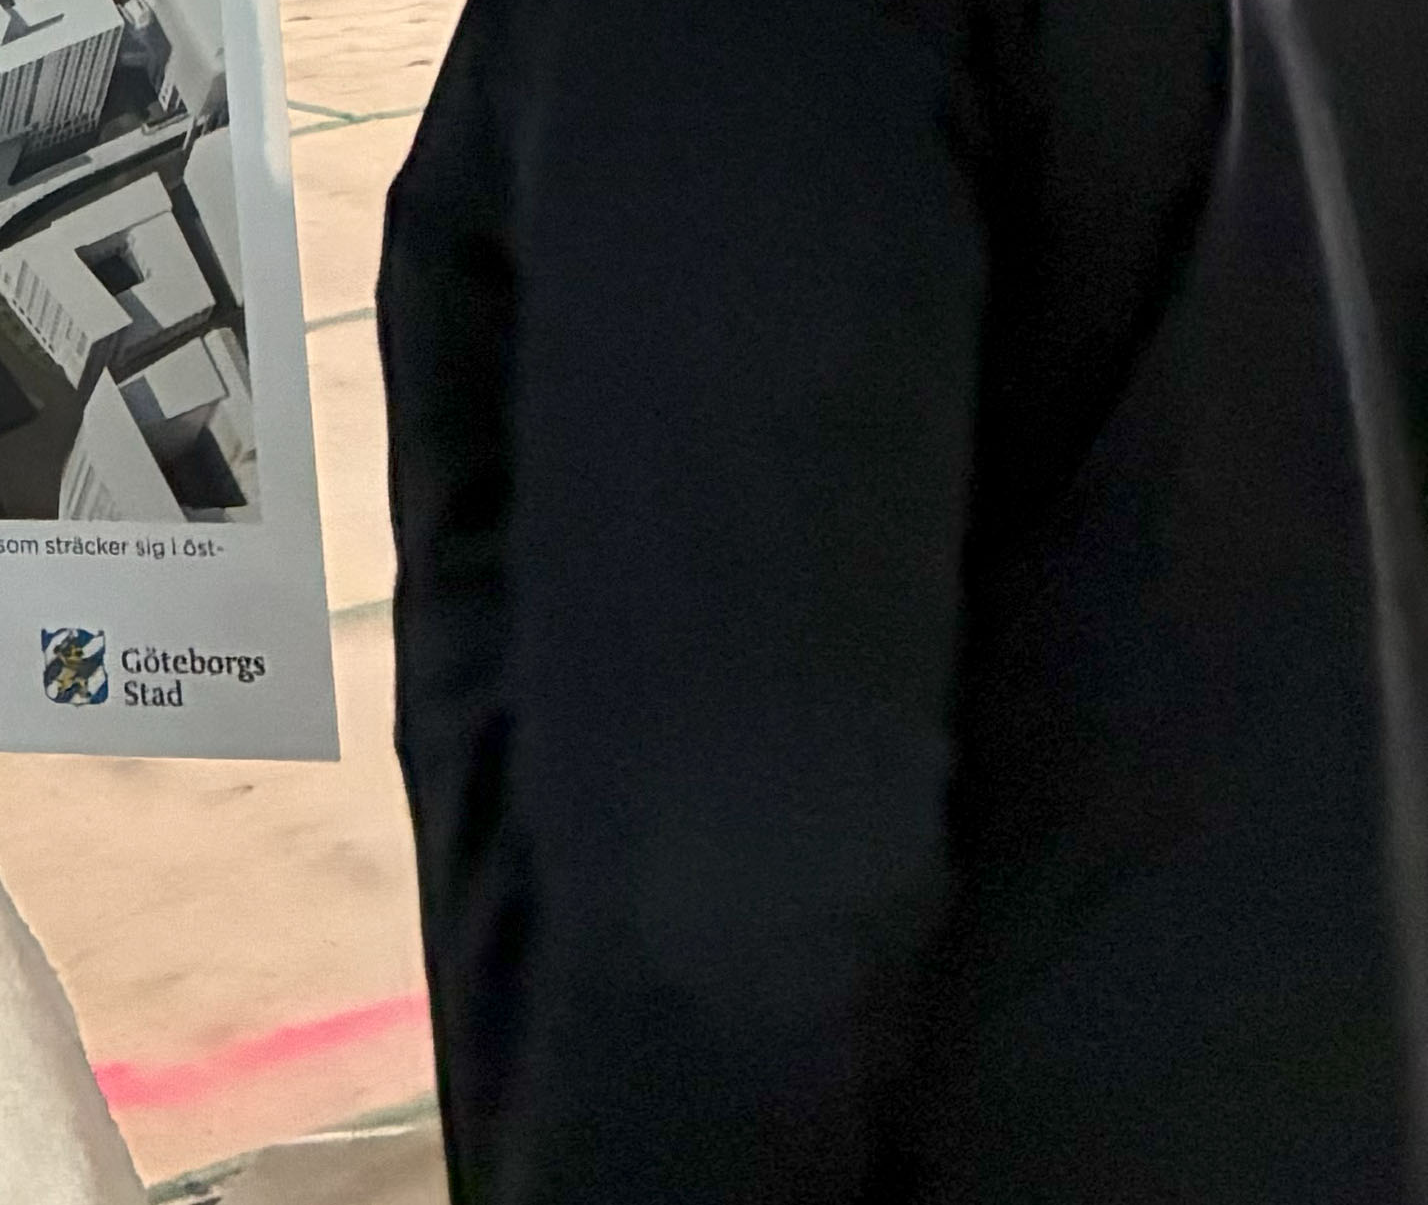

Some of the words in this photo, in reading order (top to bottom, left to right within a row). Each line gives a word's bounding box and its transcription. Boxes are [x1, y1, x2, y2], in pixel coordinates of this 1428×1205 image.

[45, 538, 127, 557] sträcker
[136, 538, 165, 560] sig
[184, 539, 224, 557] öst-
[122, 647, 266, 682] Göteborgs
[124, 679, 183, 707] Stad
